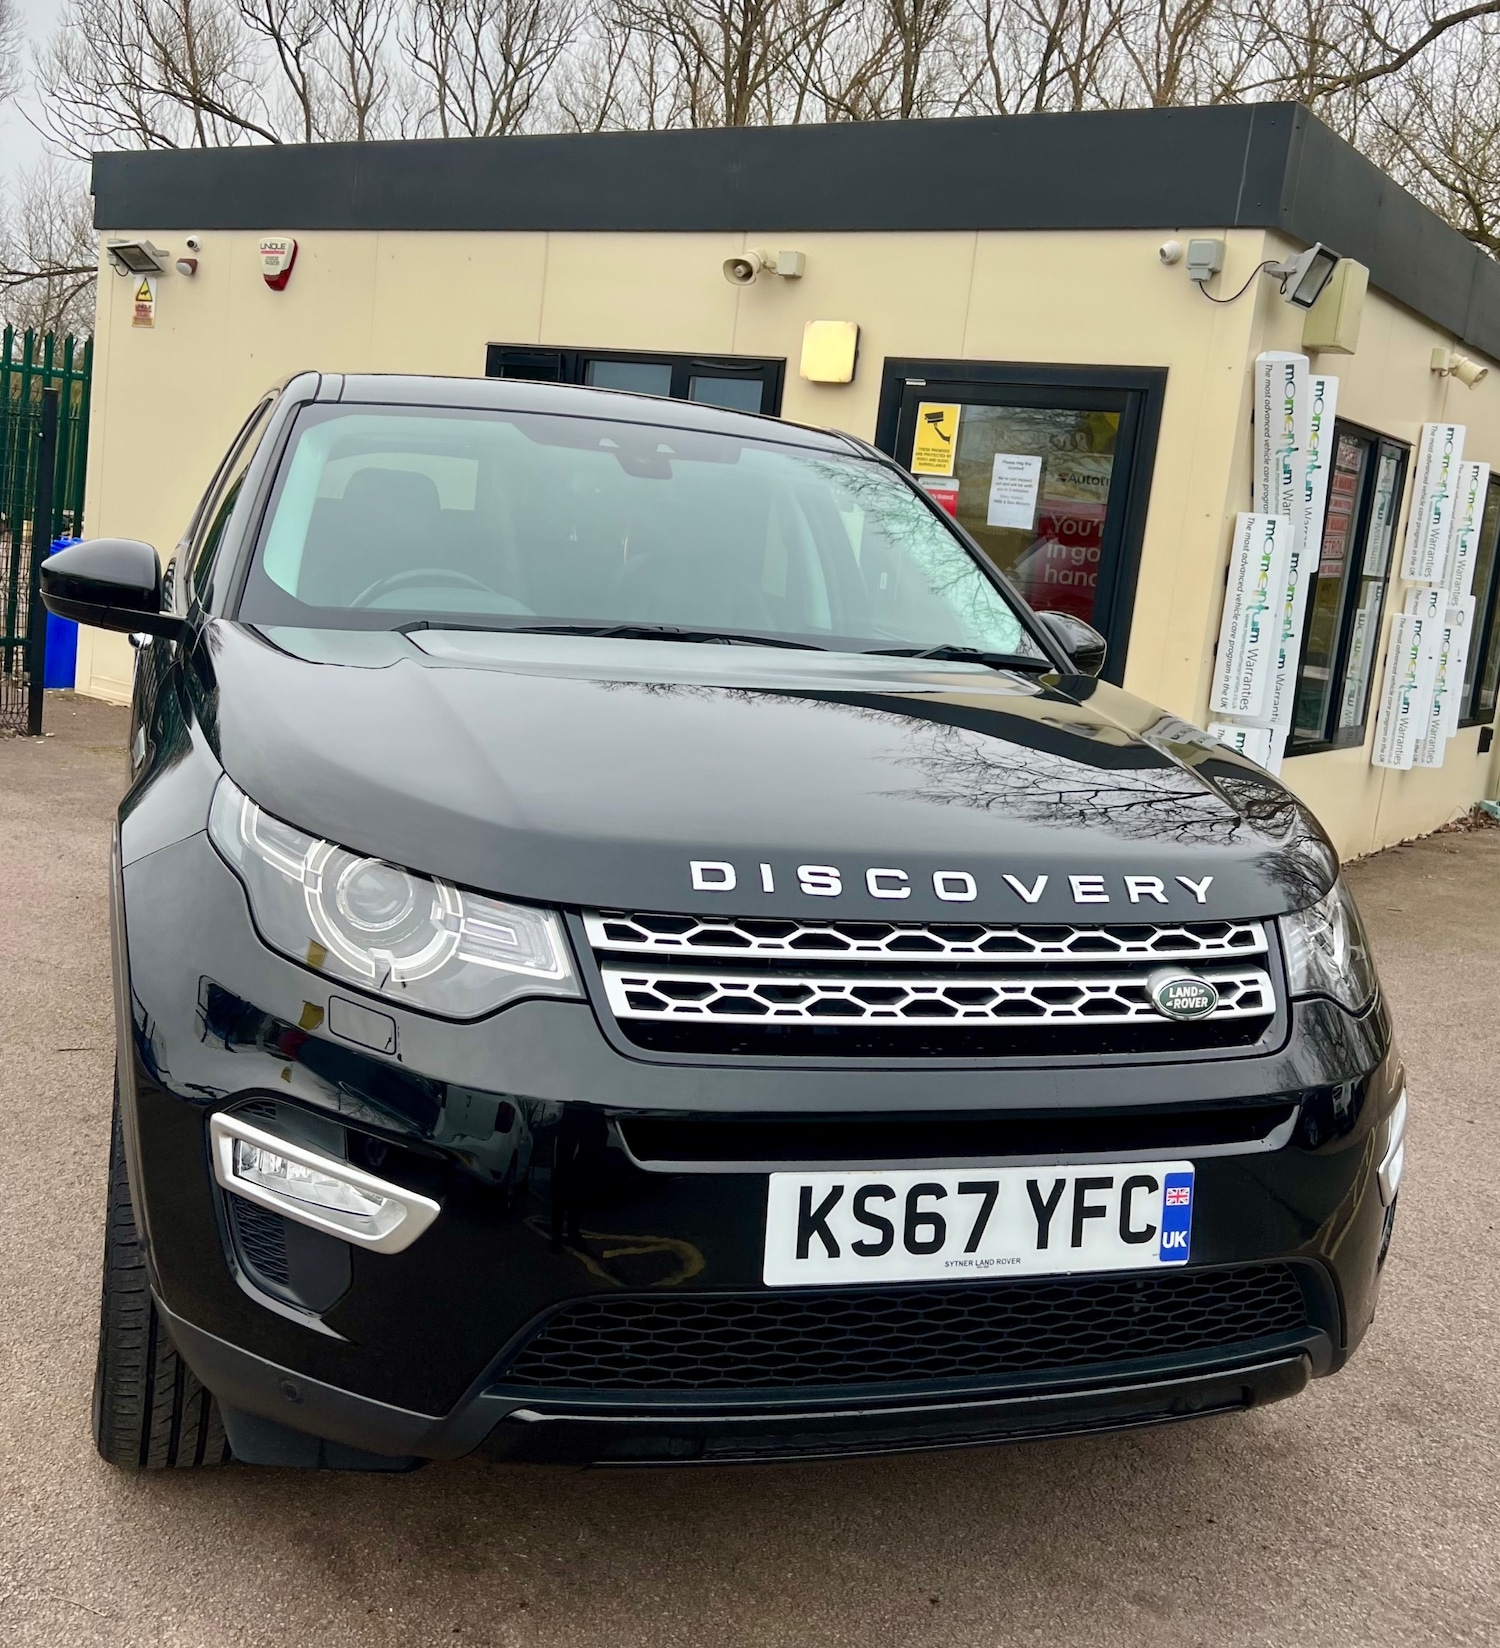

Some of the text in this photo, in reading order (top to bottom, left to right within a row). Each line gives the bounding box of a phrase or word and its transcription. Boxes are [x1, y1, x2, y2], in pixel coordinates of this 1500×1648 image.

[1264, 364, 1273, 378] The
[1264, 399, 1272, 438] advanced
[1276, 364, 1299, 485] momentum
[1430, 425, 1438, 437] The
[1263, 439, 1271, 465] vehicle
[1304, 381, 1325, 502] momentum
[1422, 453, 1432, 485] advanced
[1419, 485, 1427, 507] vehicle
[1424, 427, 1455, 578] momentum Warranties
[1457, 465, 1480, 557] momentum
[1412, 521, 1422, 549] program
[1246, 520, 1276, 643] momentum
[1409, 566, 1416, 577] UK
[1451, 560, 1467, 606] Warranties
[1220, 517, 1255, 709] The most advanced vehicle care program in the UK
[1391, 644, 1401, 675] advanced
[1239, 648, 1259, 711] Warranties
[1388, 675, 1396, 697] vehicle
[1393, 620, 1423, 766] momentum Warranties
[1270, 673, 1286, 722] Warranti
[1426, 629, 1451, 764] momentum Warranties
[1383, 710, 1391, 737] program
[1379, 754, 1386, 764] UK
[689, 860, 1215, 904] DISCOVERY
[1169, 986, 1198, 998] LAND
[1173, 997, 1208, 1009] ROVER
[796, 1174, 1159, 1260] KS67 YFC
[1162, 1230, 1187, 1249] UK
[945, 1257, 1021, 1268] SYTNER LAND ROVER
